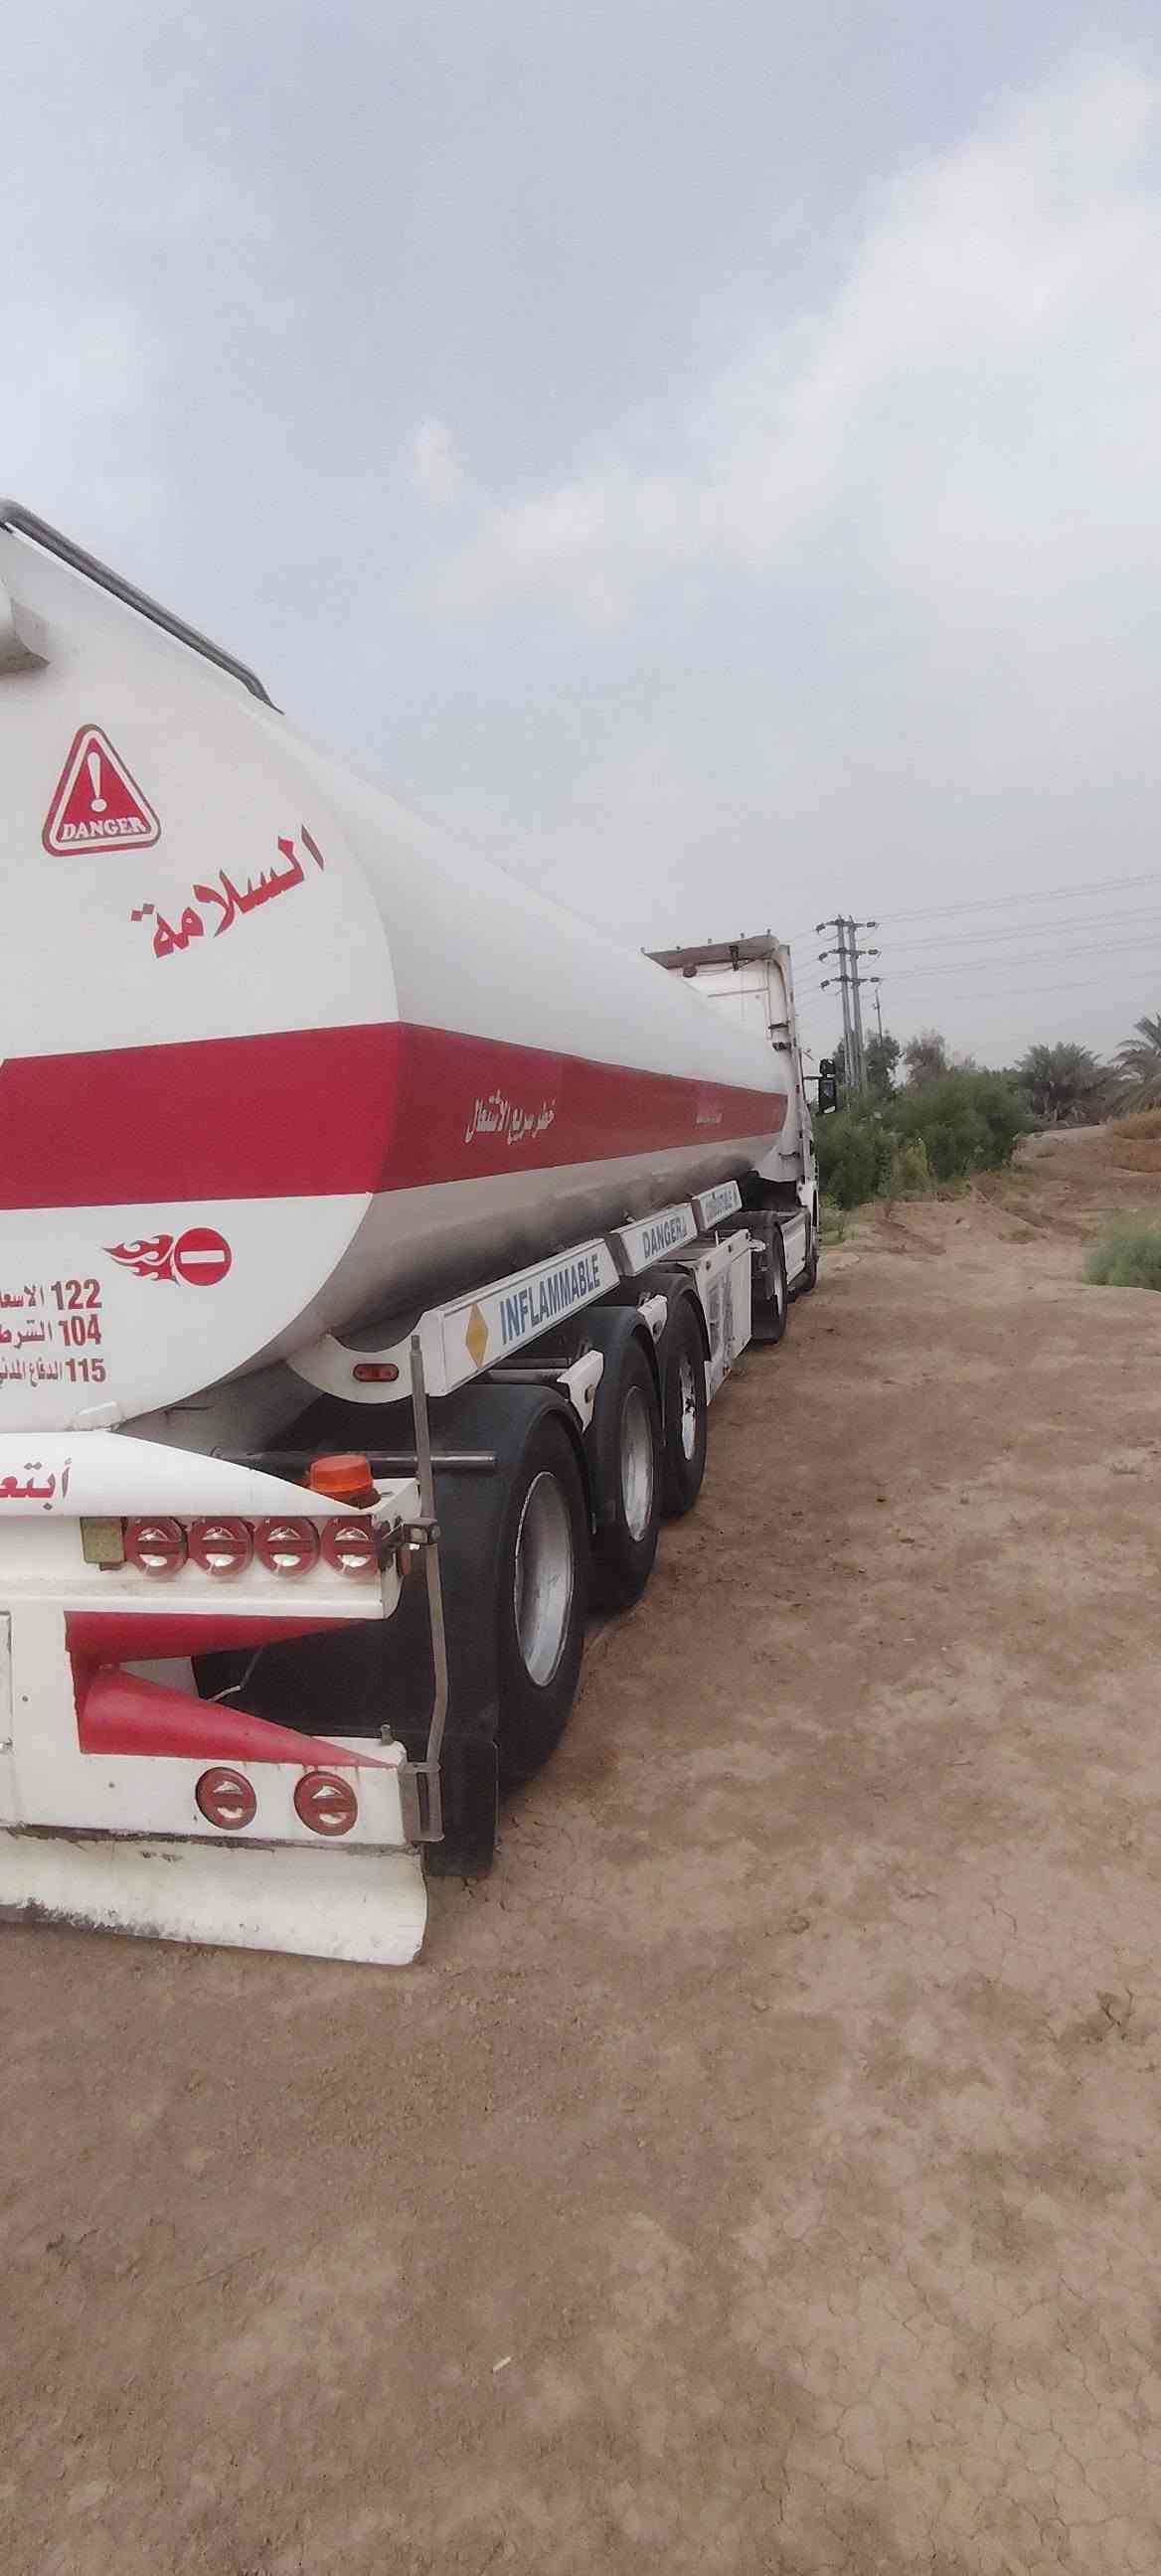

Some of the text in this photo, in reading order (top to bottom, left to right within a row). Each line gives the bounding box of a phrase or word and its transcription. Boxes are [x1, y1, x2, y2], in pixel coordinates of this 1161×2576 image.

[60, 815, 147, 842] DANGER
[130, 824, 324, 958] السلامة
[51, 1278, 102, 1311] 122
[500, 1253, 600, 1346] INFLAMMABLE
[0, 1314, 101, 1350] 104 الشرط
[65, 1358, 106, 1382] 115
[0, 1457, 72, 1511] أبتع
